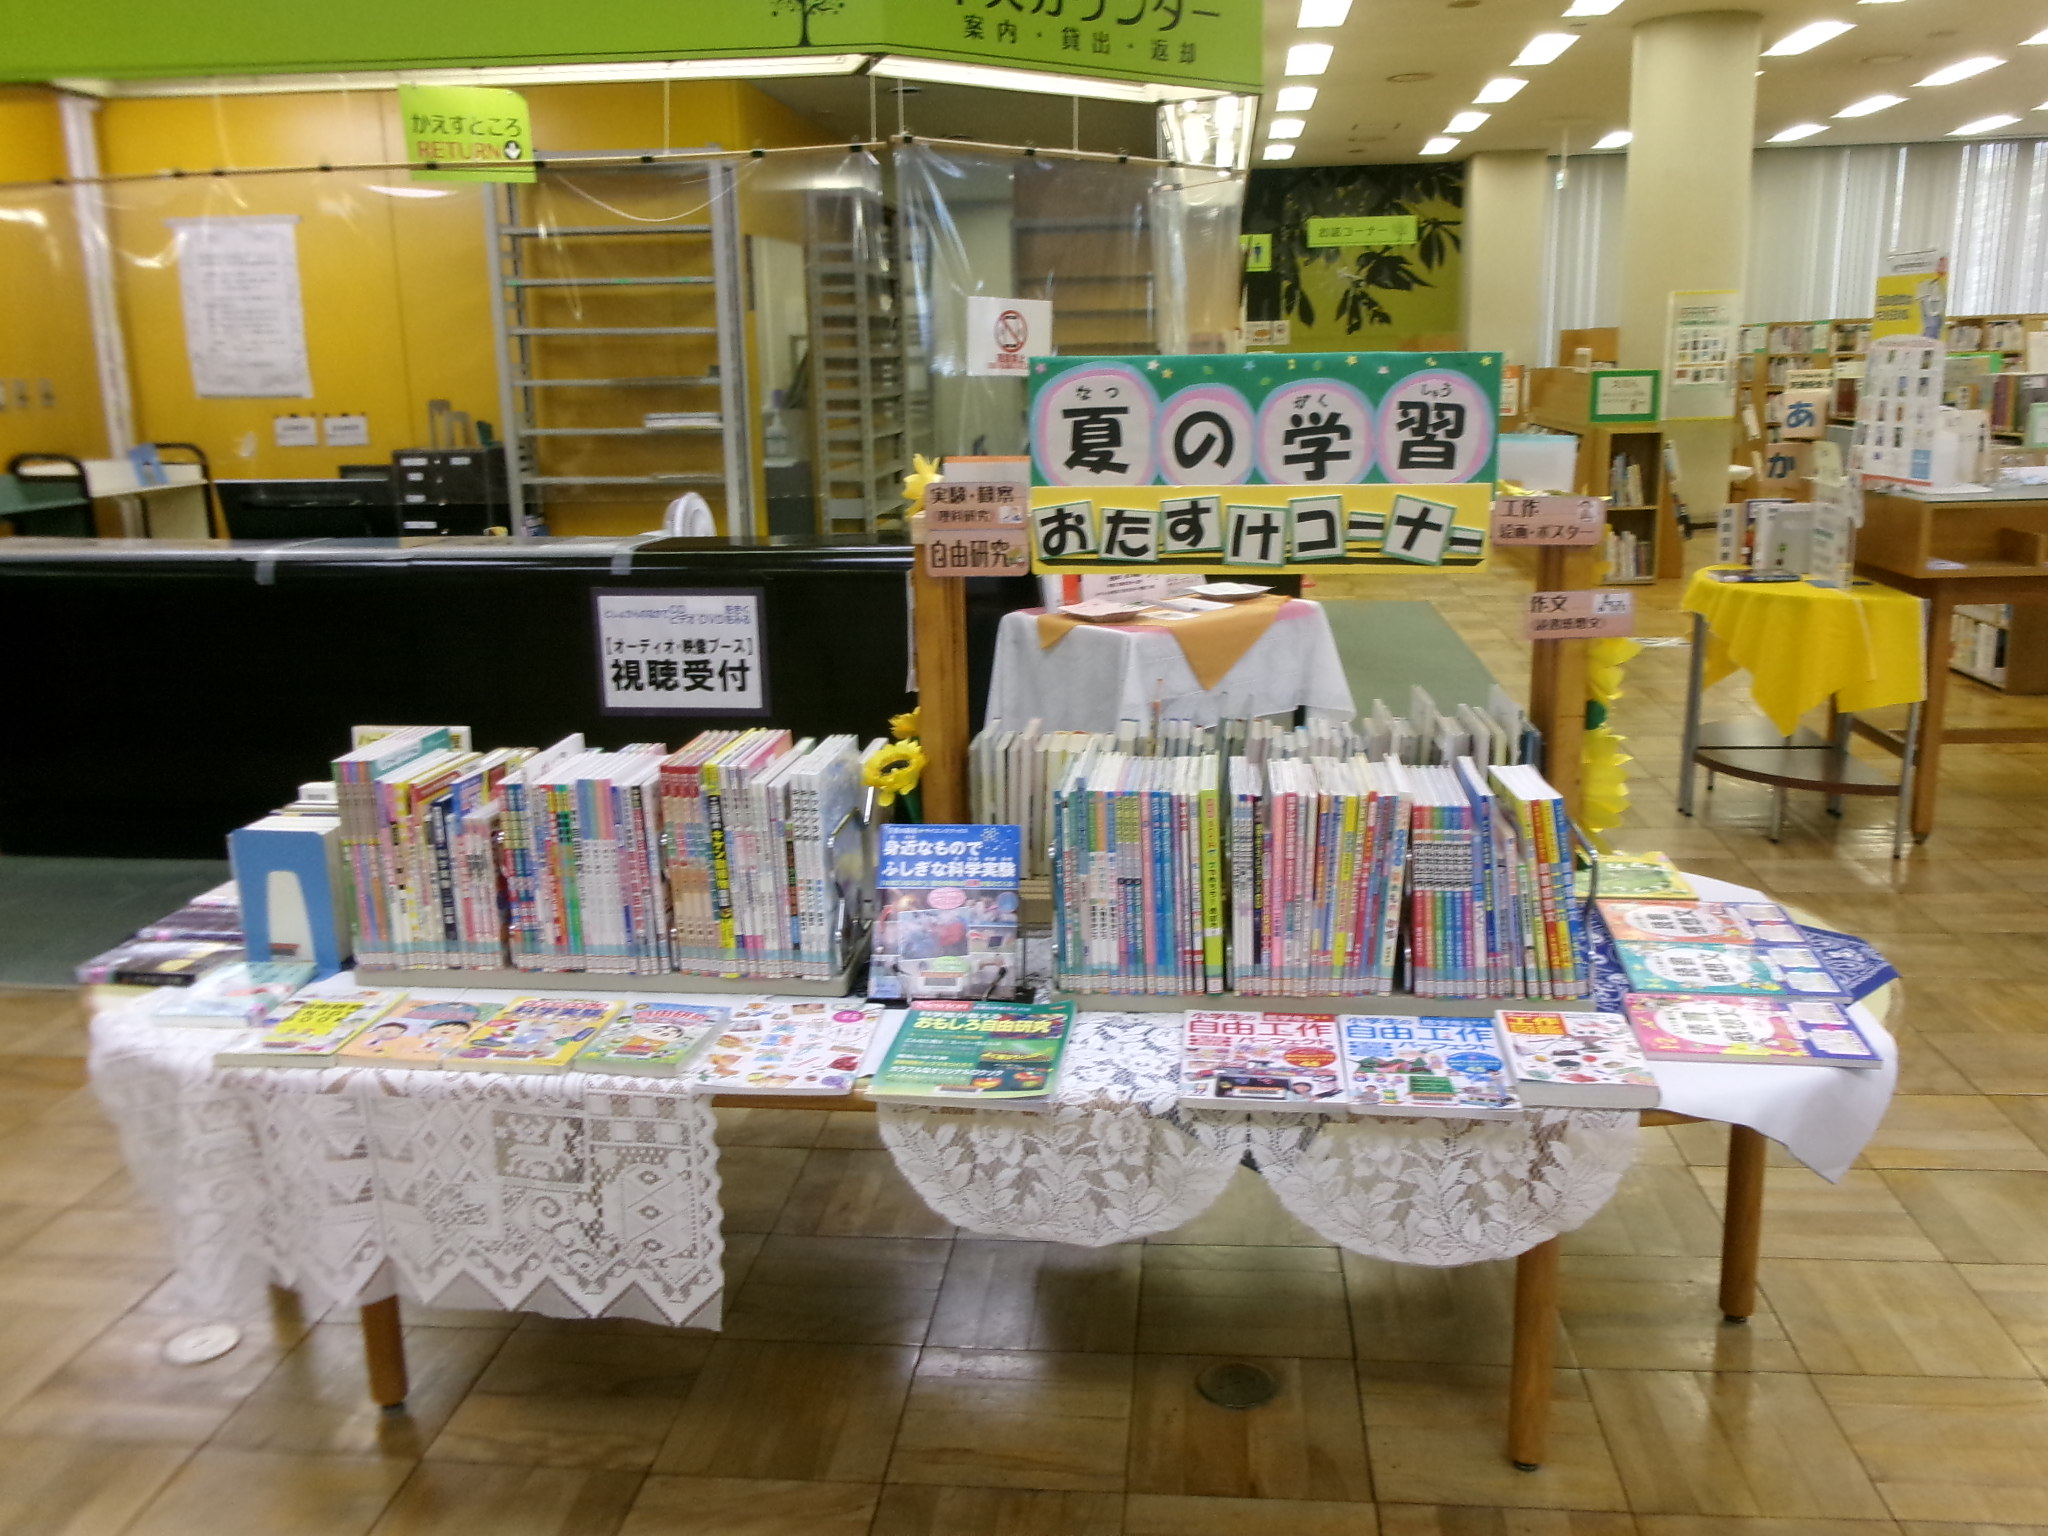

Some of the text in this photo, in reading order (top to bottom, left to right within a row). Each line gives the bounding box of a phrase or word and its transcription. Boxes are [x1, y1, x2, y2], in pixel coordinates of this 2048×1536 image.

[410, 113, 522, 138] かえすところ
[416, 140, 501, 160] RETURN
[1786, 401, 1814, 428] あ
[1062, 400, 1466, 482] 夏の学習
[1767, 452, 1796, 479] か
[929, 486, 1015, 505] 実験・観察
[1499, 499, 1539, 517] 工作
[1040, 499, 1484, 560] おたすけコーナー
[930, 540, 1010, 568] 自由研究
[1530, 595, 1568, 613] 作文
[611, 659, 750, 692] 視聴受付
[882, 840, 984, 857] 身近なもので
[880, 860, 1018, 878] ふしぎな科学実験
[913, 1016, 1052, 1034] おもしろ自由研究
[1189, 1021, 1334, 1037] 自由工作
[1346, 1025, 1493, 1042] 自由工作
[1237, 1037, 1333, 1046] パーフェクト
